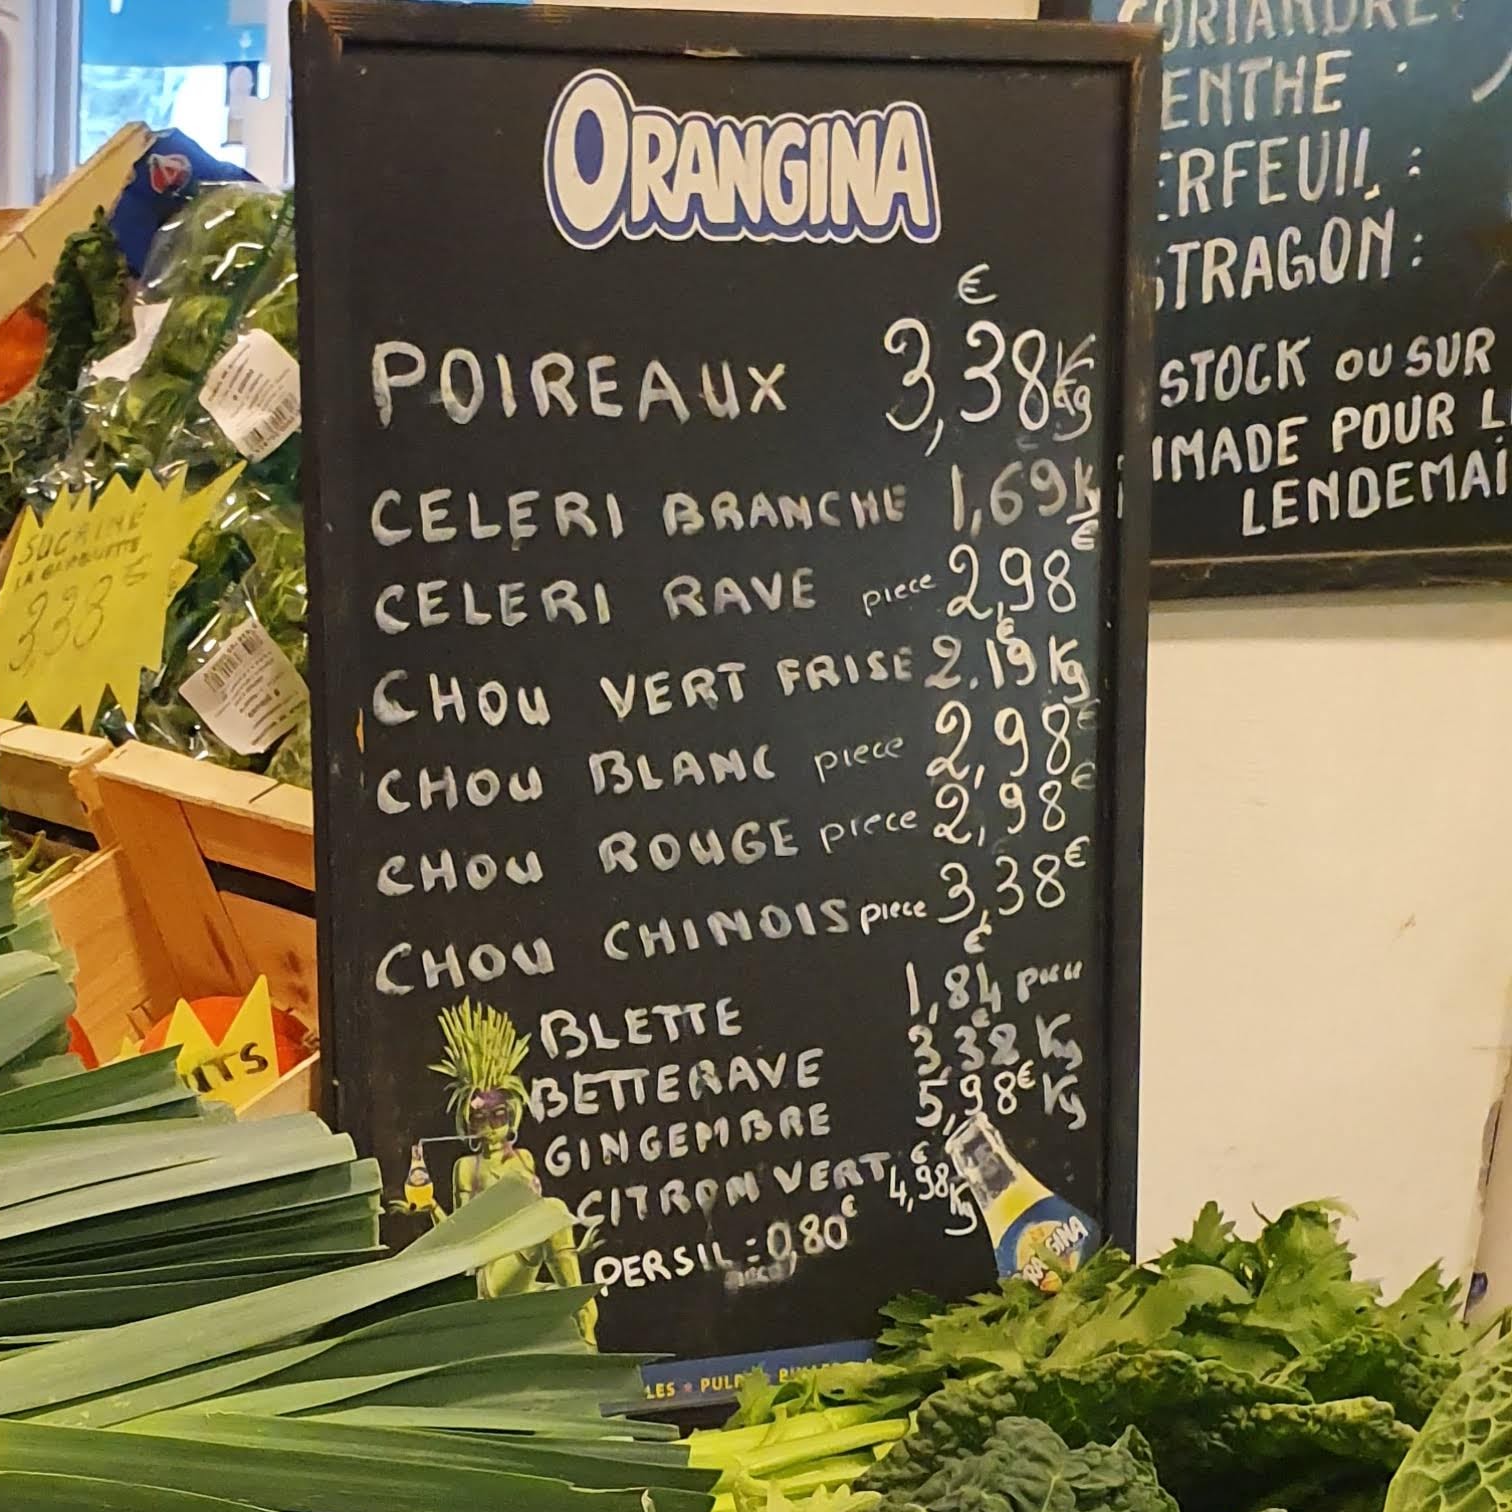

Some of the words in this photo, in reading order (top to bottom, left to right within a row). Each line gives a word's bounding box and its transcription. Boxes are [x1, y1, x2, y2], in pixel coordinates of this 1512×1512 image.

[546, 70, 940, 249] ORANGINA
[373, 341, 788, 427] POIREAUX
[1159, 336, 1311, 408] STOCK
[1405, 327, 1496, 378] SUR
[1332, 391, 1456, 453] POUR
[371, 488, 625, 548] CELERI
[662, 484, 907, 538] BRANCHE
[375, 579, 611, 634] CELERI
[662, 567, 818, 621] RAVE
[372, 669, 551, 726] CHOU
[600, 662, 746, 722] VERT
[775, 646, 913, 696] FRISE
[376, 766, 544, 814] CHOU
[588, 744, 776, 795] BLANC
[376, 849, 544, 897] CHOU
[598, 819, 799, 874] ROUGE
[374, 937, 556, 996] CHOU
[603, 898, 850, 961] CHINOIS
[539, 996, 744, 1060] BLETTE
[530, 1048, 824, 1124] BETTERAVE
[544, 1102, 831, 1178] GINGEMBRE
[577, 1171, 761, 1228] CITRON
[773, 1152, 892, 1195] VERT
[593, 1240, 736, 1297] PERSIL
